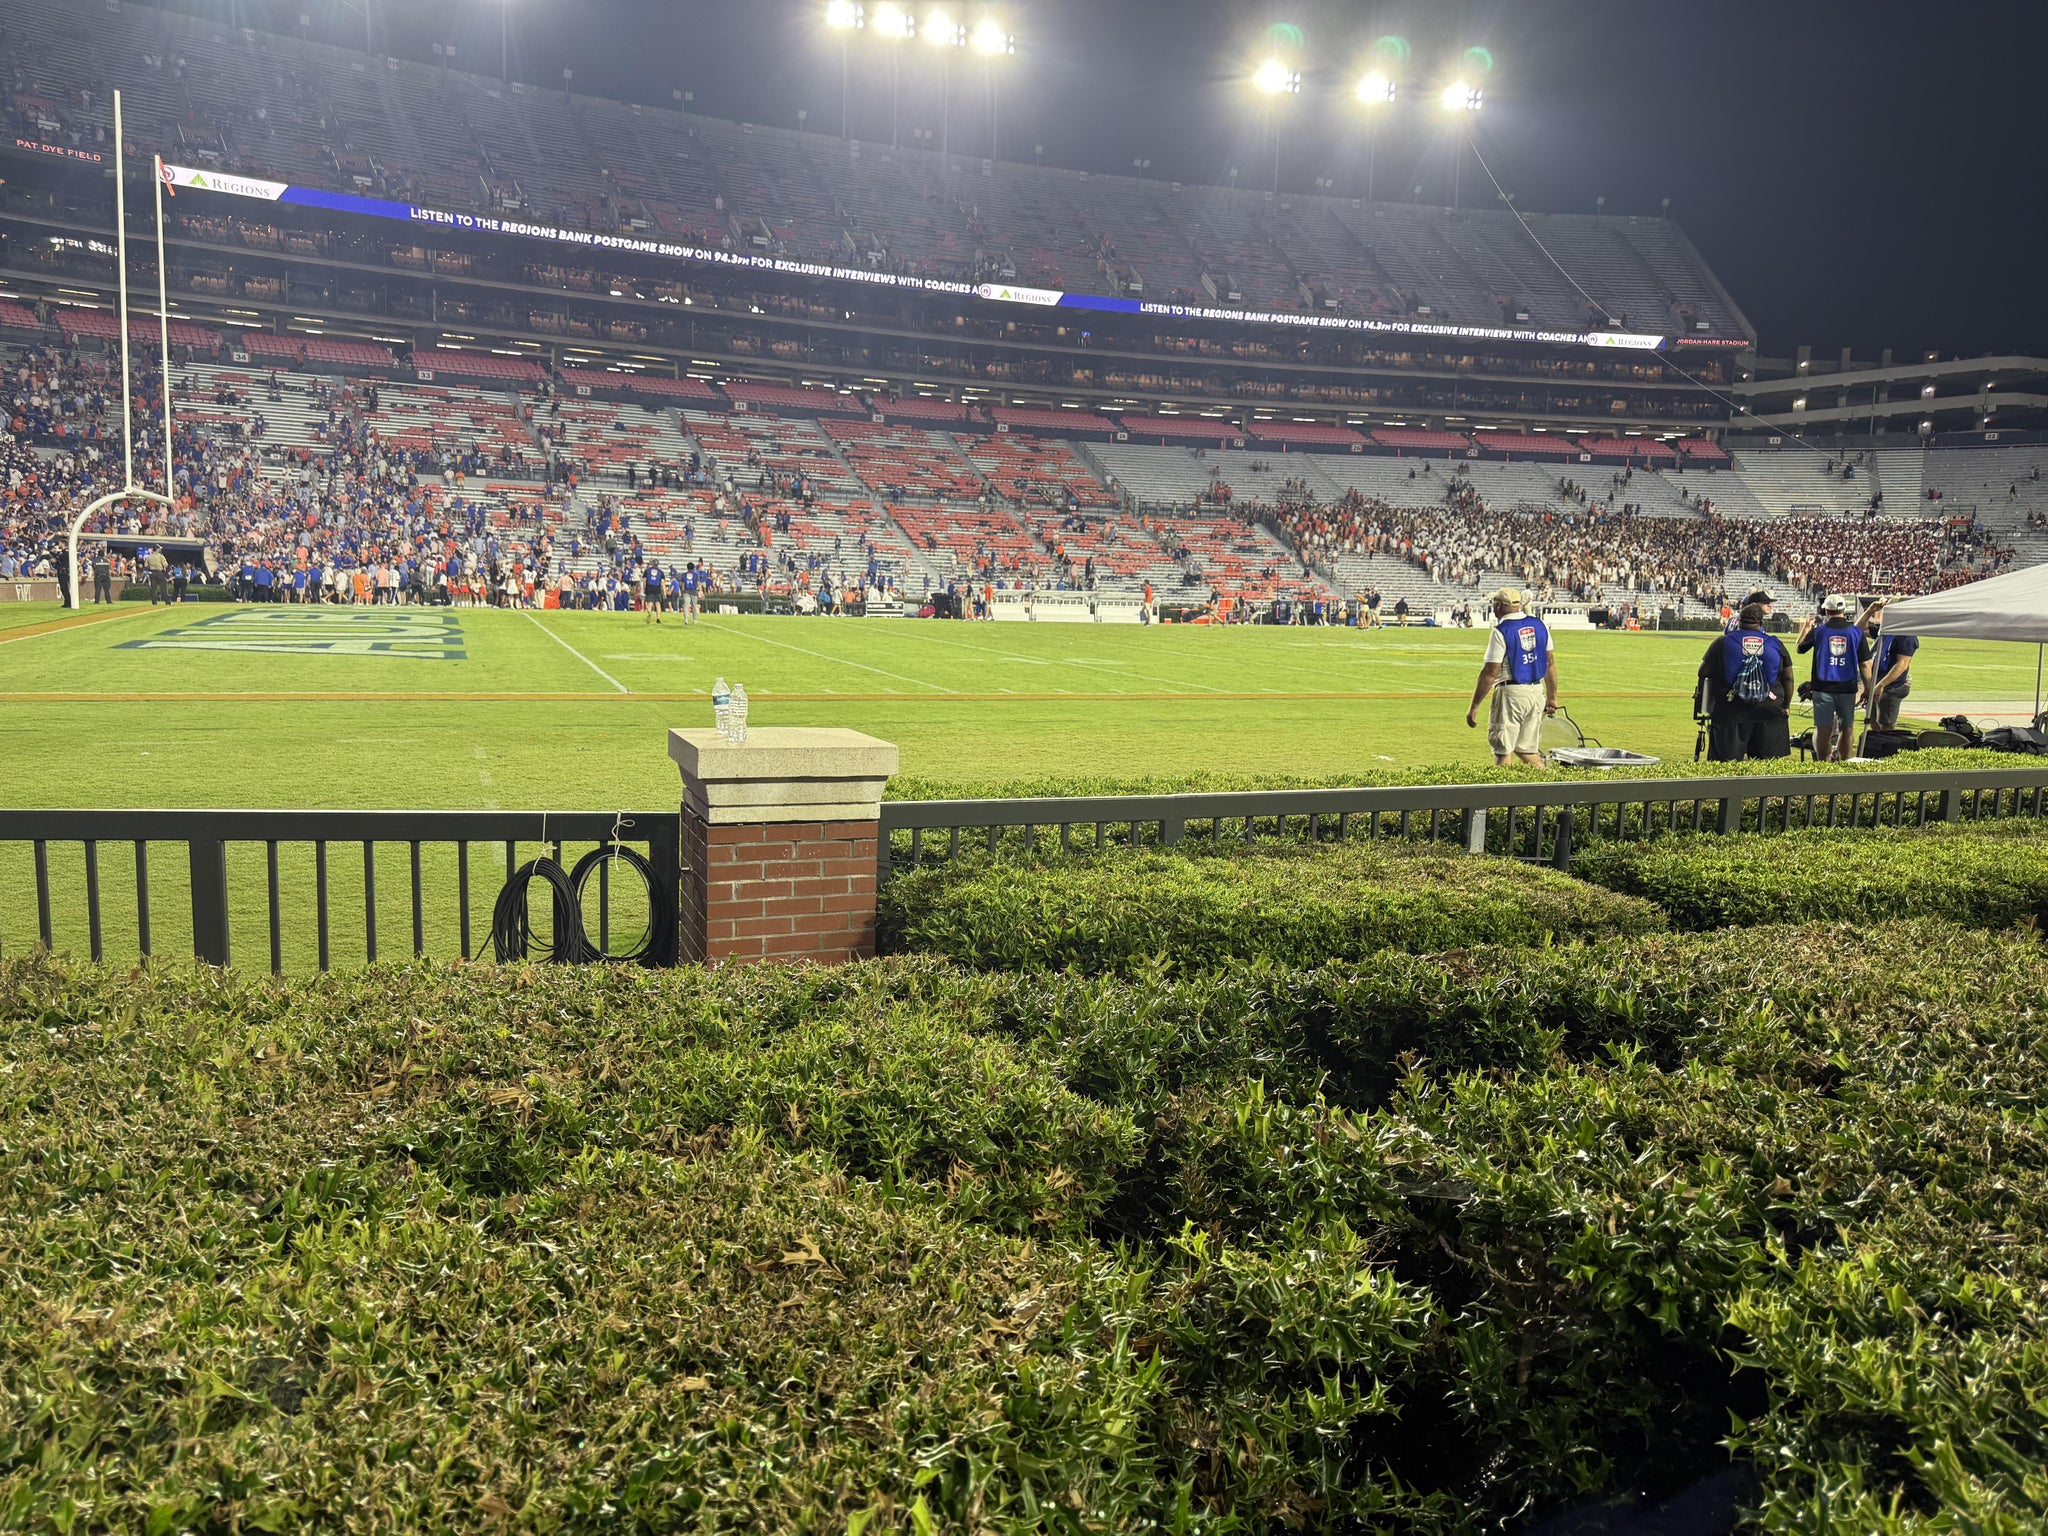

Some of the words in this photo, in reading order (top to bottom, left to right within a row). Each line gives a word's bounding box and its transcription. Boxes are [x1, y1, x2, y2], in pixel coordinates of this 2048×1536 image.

[16, 139, 38, 150] PAT
[42, 144, 64, 155] DYE
[67, 149, 102, 162] FIELD
[212, 178, 270, 197] REGIONS
[410, 207, 454, 224] LISTEN
[456, 214, 473, 226] TO
[475, 217, 500, 230] THE
[501, 221, 557, 239] REGIONS
[558, 229, 593, 244] BANK
[593, 234, 658, 253] POSTGAME
[658, 243, 694, 258] SHOW
[695, 248, 712, 260] ON
[751, 256, 773, 269] FOR
[774, 259, 832, 277] EXCLUSIVE
[833, 267, 896, 285] INTERVIEWS
[897, 275, 923, 288] WITH
[924, 279, 970, 294] COACHES
[1140, 302, 1169, 315] LISTEN
[1171, 305, 1183, 315] TO
[1184, 307, 1202, 317] THE
[1202, 308, 1244, 320] REGIONS
[1244, 311, 1270, 322] BANK
[1270, 313, 1319, 326] POSTGAME
[1319, 318, 1348, 328] SHOW
[1348, 319, 1362, 329] ON
[1392, 323, 1410, 332] FOR
[1411, 323, 1458, 336] EXCLUSIVE
[1459, 327, 1513, 339] INTERVIEWS
[1513, 330, 1536, 340] WITH
[1536, 332, 1577, 343] COACHES
[1676, 338, 1720, 346] JORDAN-HARE
[235, 353, 248, 361] 34
